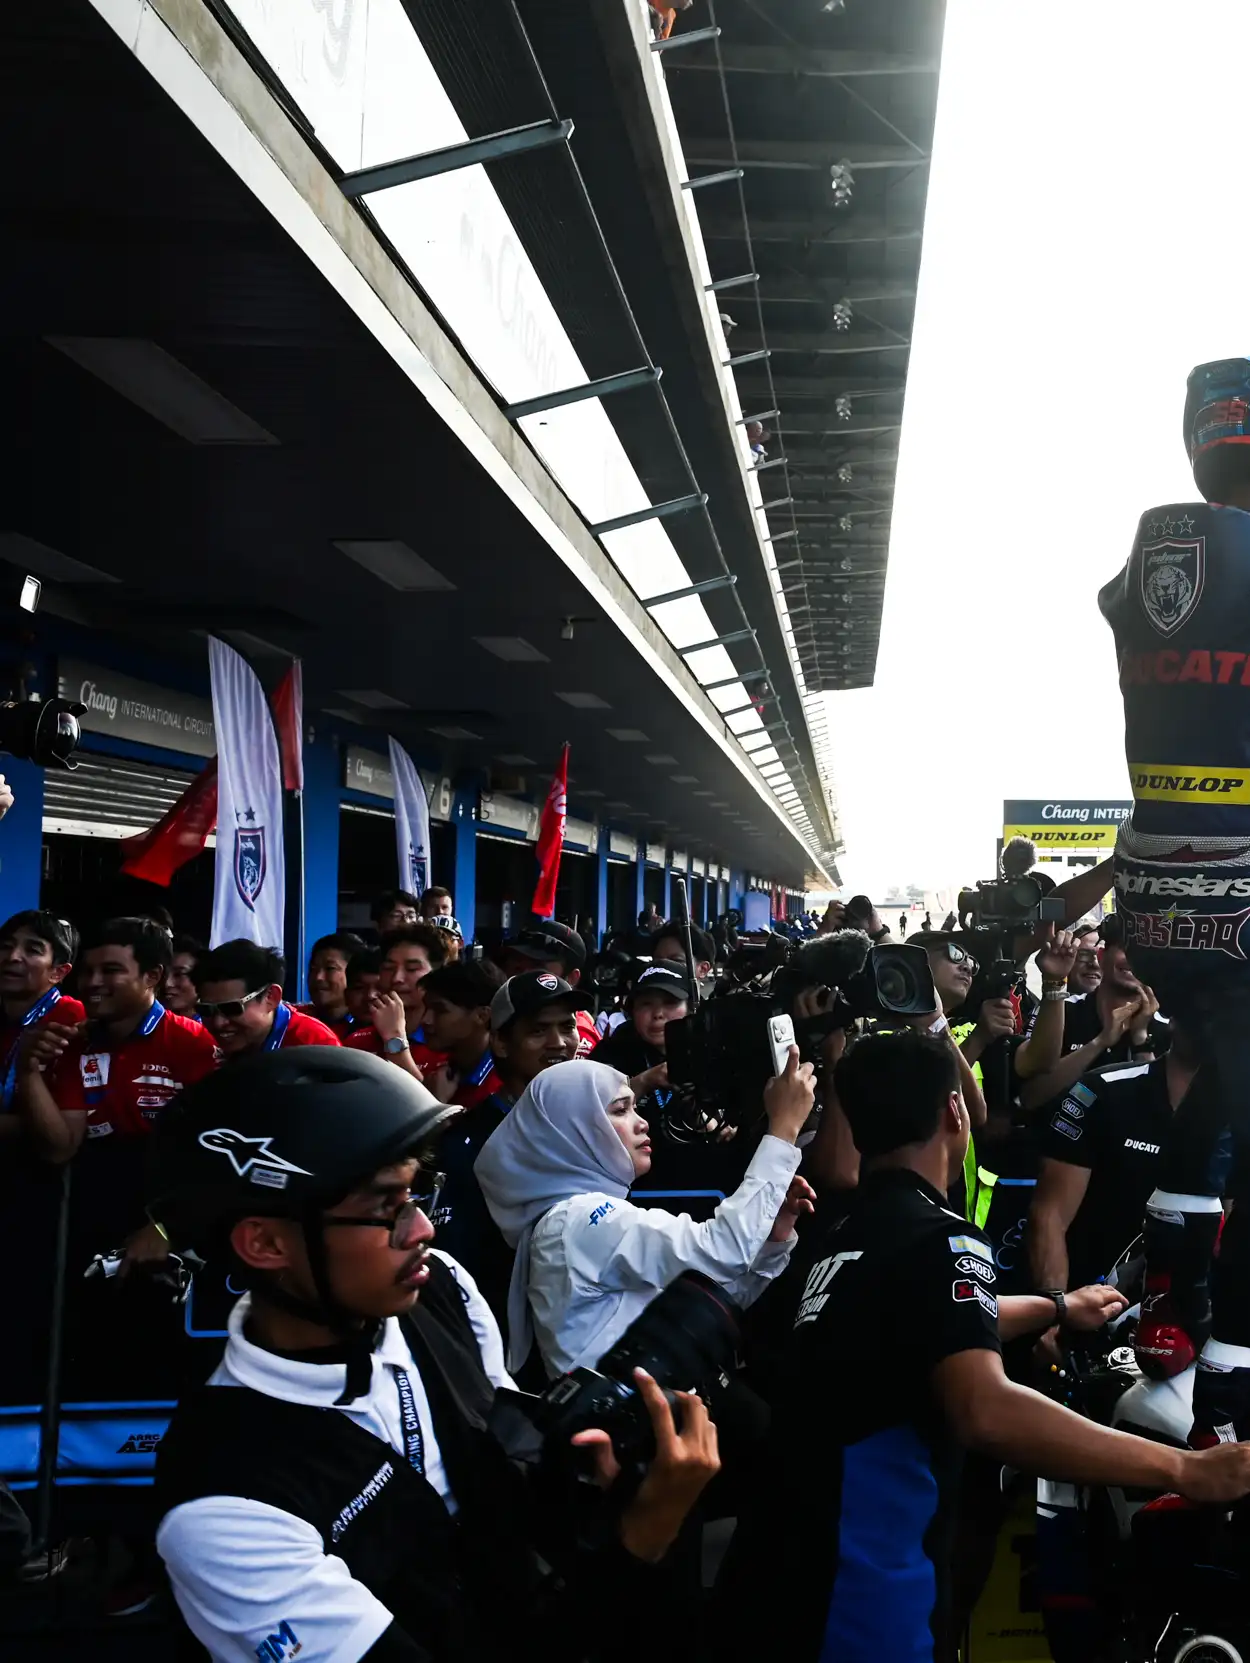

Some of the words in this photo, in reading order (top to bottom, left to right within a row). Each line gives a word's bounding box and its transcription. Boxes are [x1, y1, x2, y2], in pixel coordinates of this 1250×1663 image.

[79, 680, 118, 719] Chang
[120, 699, 182, 729] INTERNATIONAL
[184, 716, 213, 737] CIRCUIT
[1135, 773, 1244, 793] DUNLOP
[439, 777, 451, 816] 6
[1041, 804, 1090, 821] Chang
[1093, 808, 1133, 819] INTER
[1030, 832, 1106, 841] DUNLOP
[1063, 1100, 1081, 1117] SHOEI
[1124, 1137, 1161, 1154] DUCATI
[962, 1257, 992, 1280] SHOEI
[127, 1434, 161, 1442] ARRC
